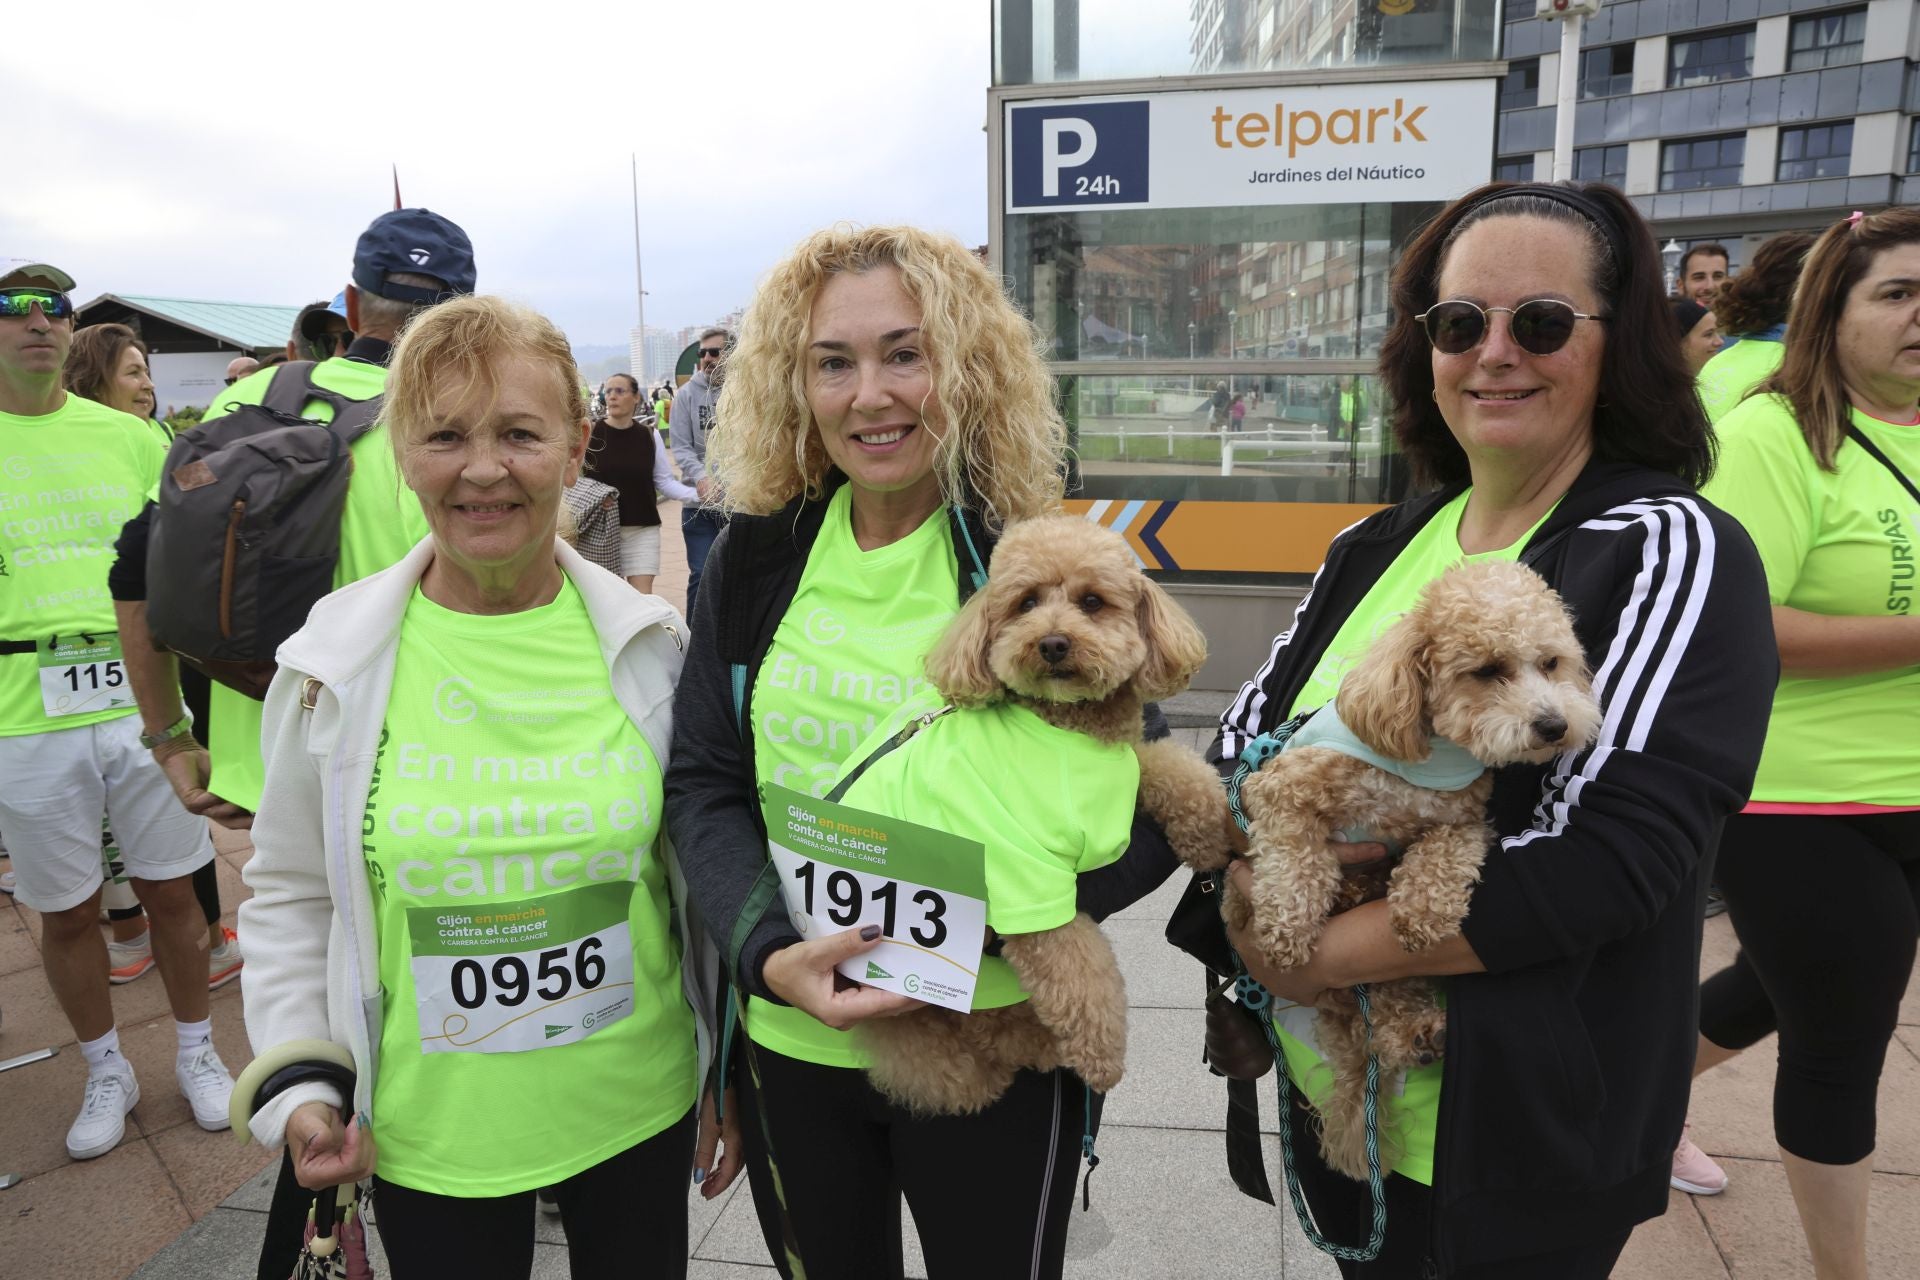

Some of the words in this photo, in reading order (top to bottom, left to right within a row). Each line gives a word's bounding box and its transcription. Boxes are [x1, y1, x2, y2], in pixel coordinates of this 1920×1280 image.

[1211, 98, 1430, 159] telpark
[1042, 117, 1098, 197] P
[1248, 168, 1322, 184] Jardines
[1326, 167, 1352, 182] del
[1356, 164, 1425, 181] Náutico
[1075, 174, 1121, 196] 24h
[36, 480, 129, 507] marcha
[3, 509, 103, 538] contra
[108, 502, 130, 526] el
[12, 534, 119, 568] cánce
[64, 661, 124, 692] 115
[768, 651, 818, 693] En
[831, 670, 930, 704] mar
[762, 710, 877, 752] cont
[396, 742, 456, 781] En
[472, 739, 649, 783] marcha
[387, 796, 597, 838] contra
[607, 784, 651, 831] el
[787, 804, 817, 824] Gijón
[818, 817, 834, 829] en
[837, 820, 888, 842] marcha
[787, 820, 824, 841] contra
[826, 832, 839, 845] el
[841, 837, 888, 855] cáncer
[793, 834, 820, 849] CARRERA
[820, 844, 848, 857] CONTRA
[848, 851, 857, 859] EL
[396, 843, 647, 897] cáncer
[436, 914, 472, 927] Gijón
[474, 915, 492, 924] en
[495, 906, 546, 923] marcha
[795, 860, 948, 949] 1913
[438, 927, 483, 937] contra
[485, 924, 499, 936] el
[502, 919, 548, 935] cáncer
[480, 937, 509, 945] CONTRA
[450, 936, 606, 1009] 0956
